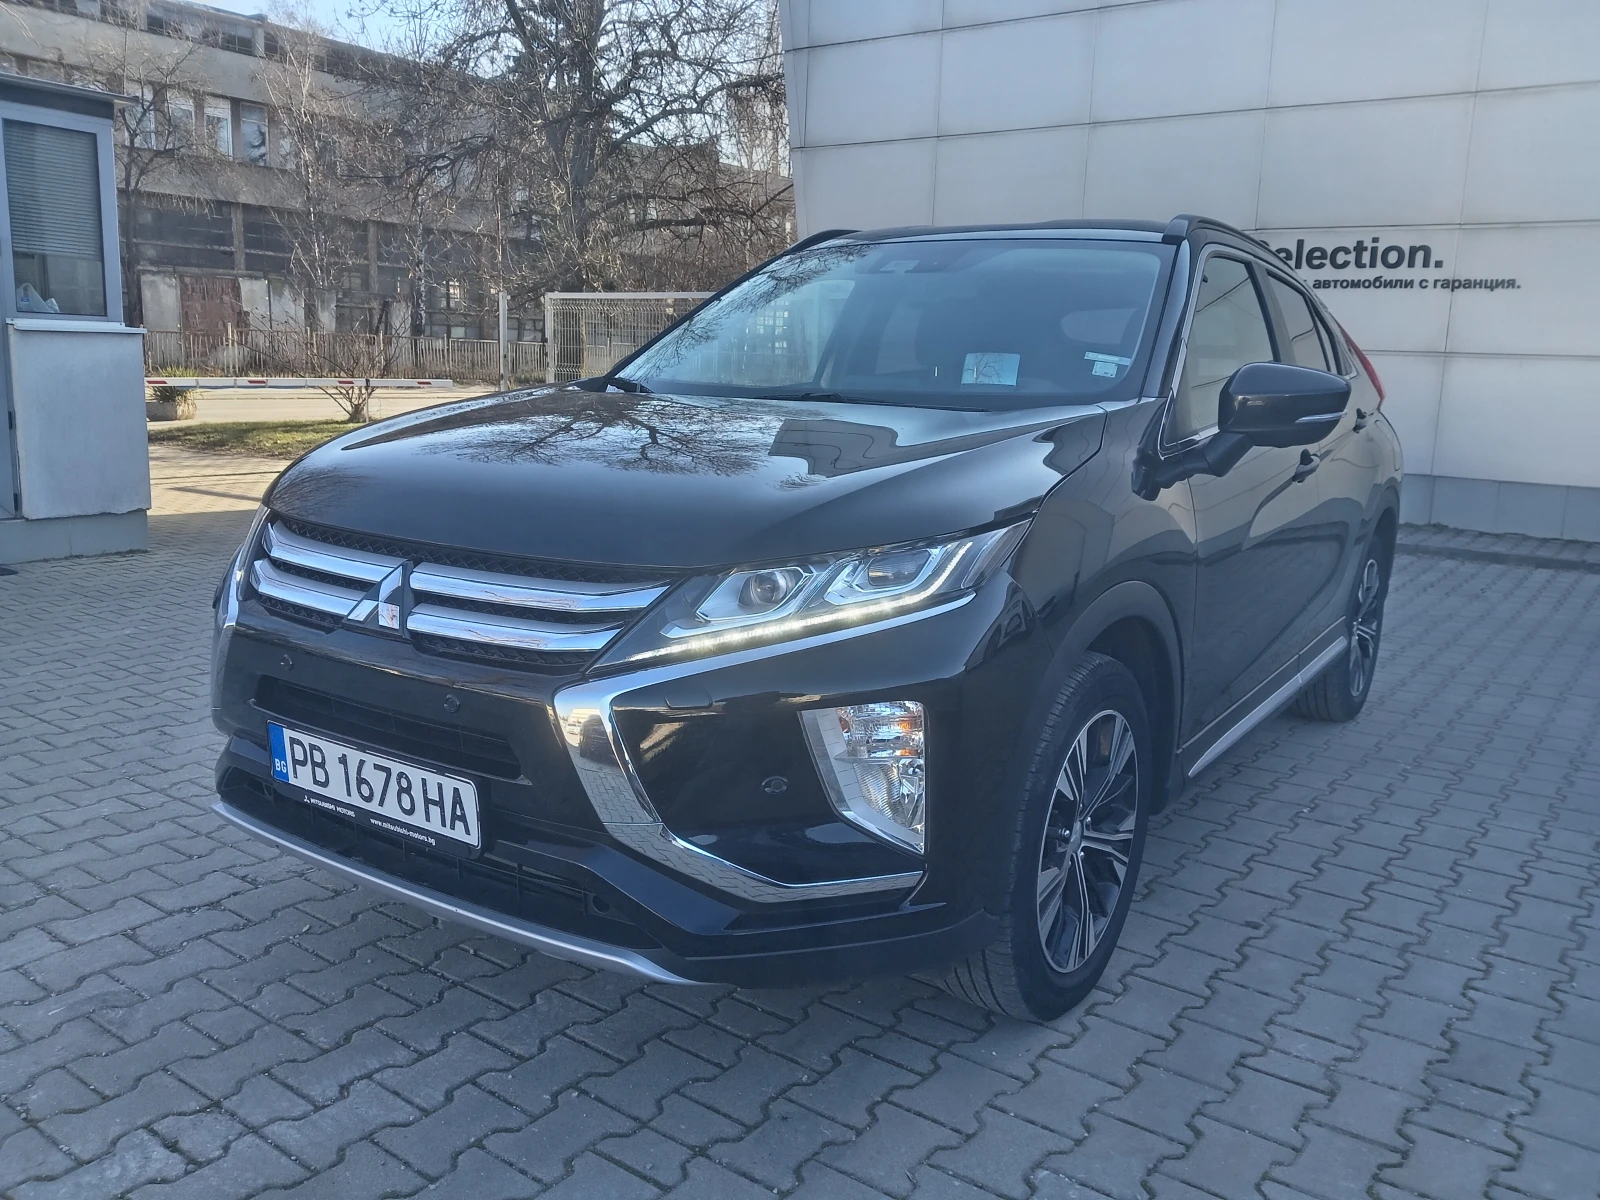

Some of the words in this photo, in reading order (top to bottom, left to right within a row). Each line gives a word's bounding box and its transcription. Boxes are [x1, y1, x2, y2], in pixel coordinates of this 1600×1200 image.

[1312, 276, 1415, 290] автомобили
[1433, 277, 1521, 292] гаранция.
[274, 758, 287, 774] BG
[310, 797, 336, 812] MITSUBISHI
[336, 805, 356, 818] MOTORS
[369, 818, 436, 846] www.mitsubishi-motors.bg
